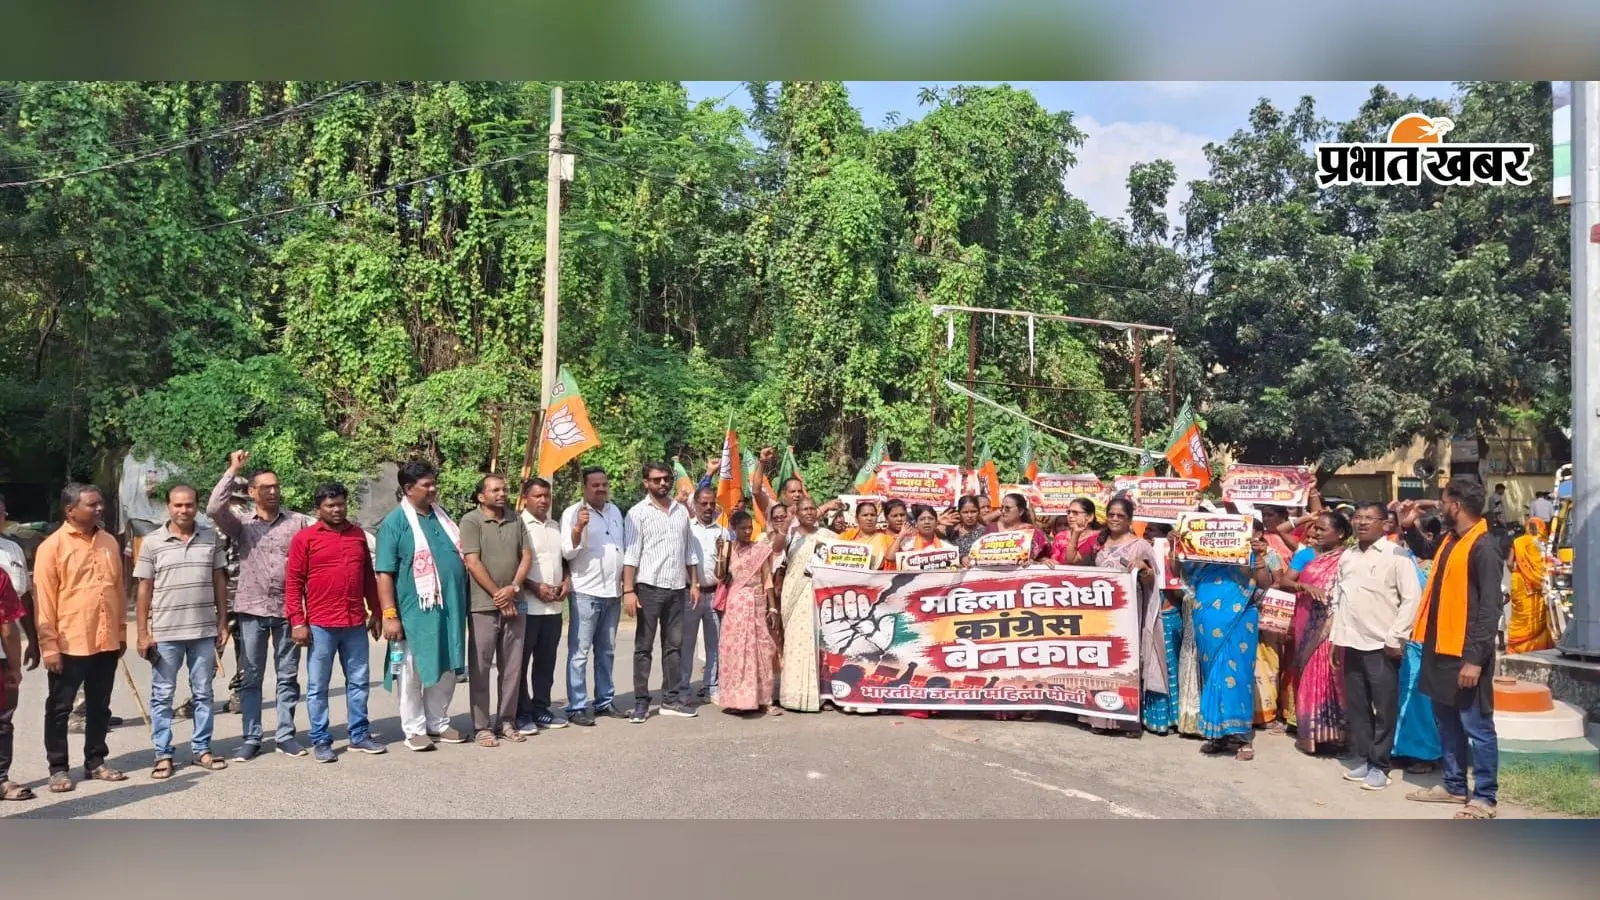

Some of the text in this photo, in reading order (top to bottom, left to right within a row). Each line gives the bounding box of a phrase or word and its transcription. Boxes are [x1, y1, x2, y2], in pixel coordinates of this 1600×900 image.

[920, 579, 1116, 615] महिला विरोधी
[953, 611, 1083, 639] कांग्रेस
[941, 638, 1113, 670] बेनकाब
[860, 683, 1086, 704] भारतीय जनता महिला मोर्चा
